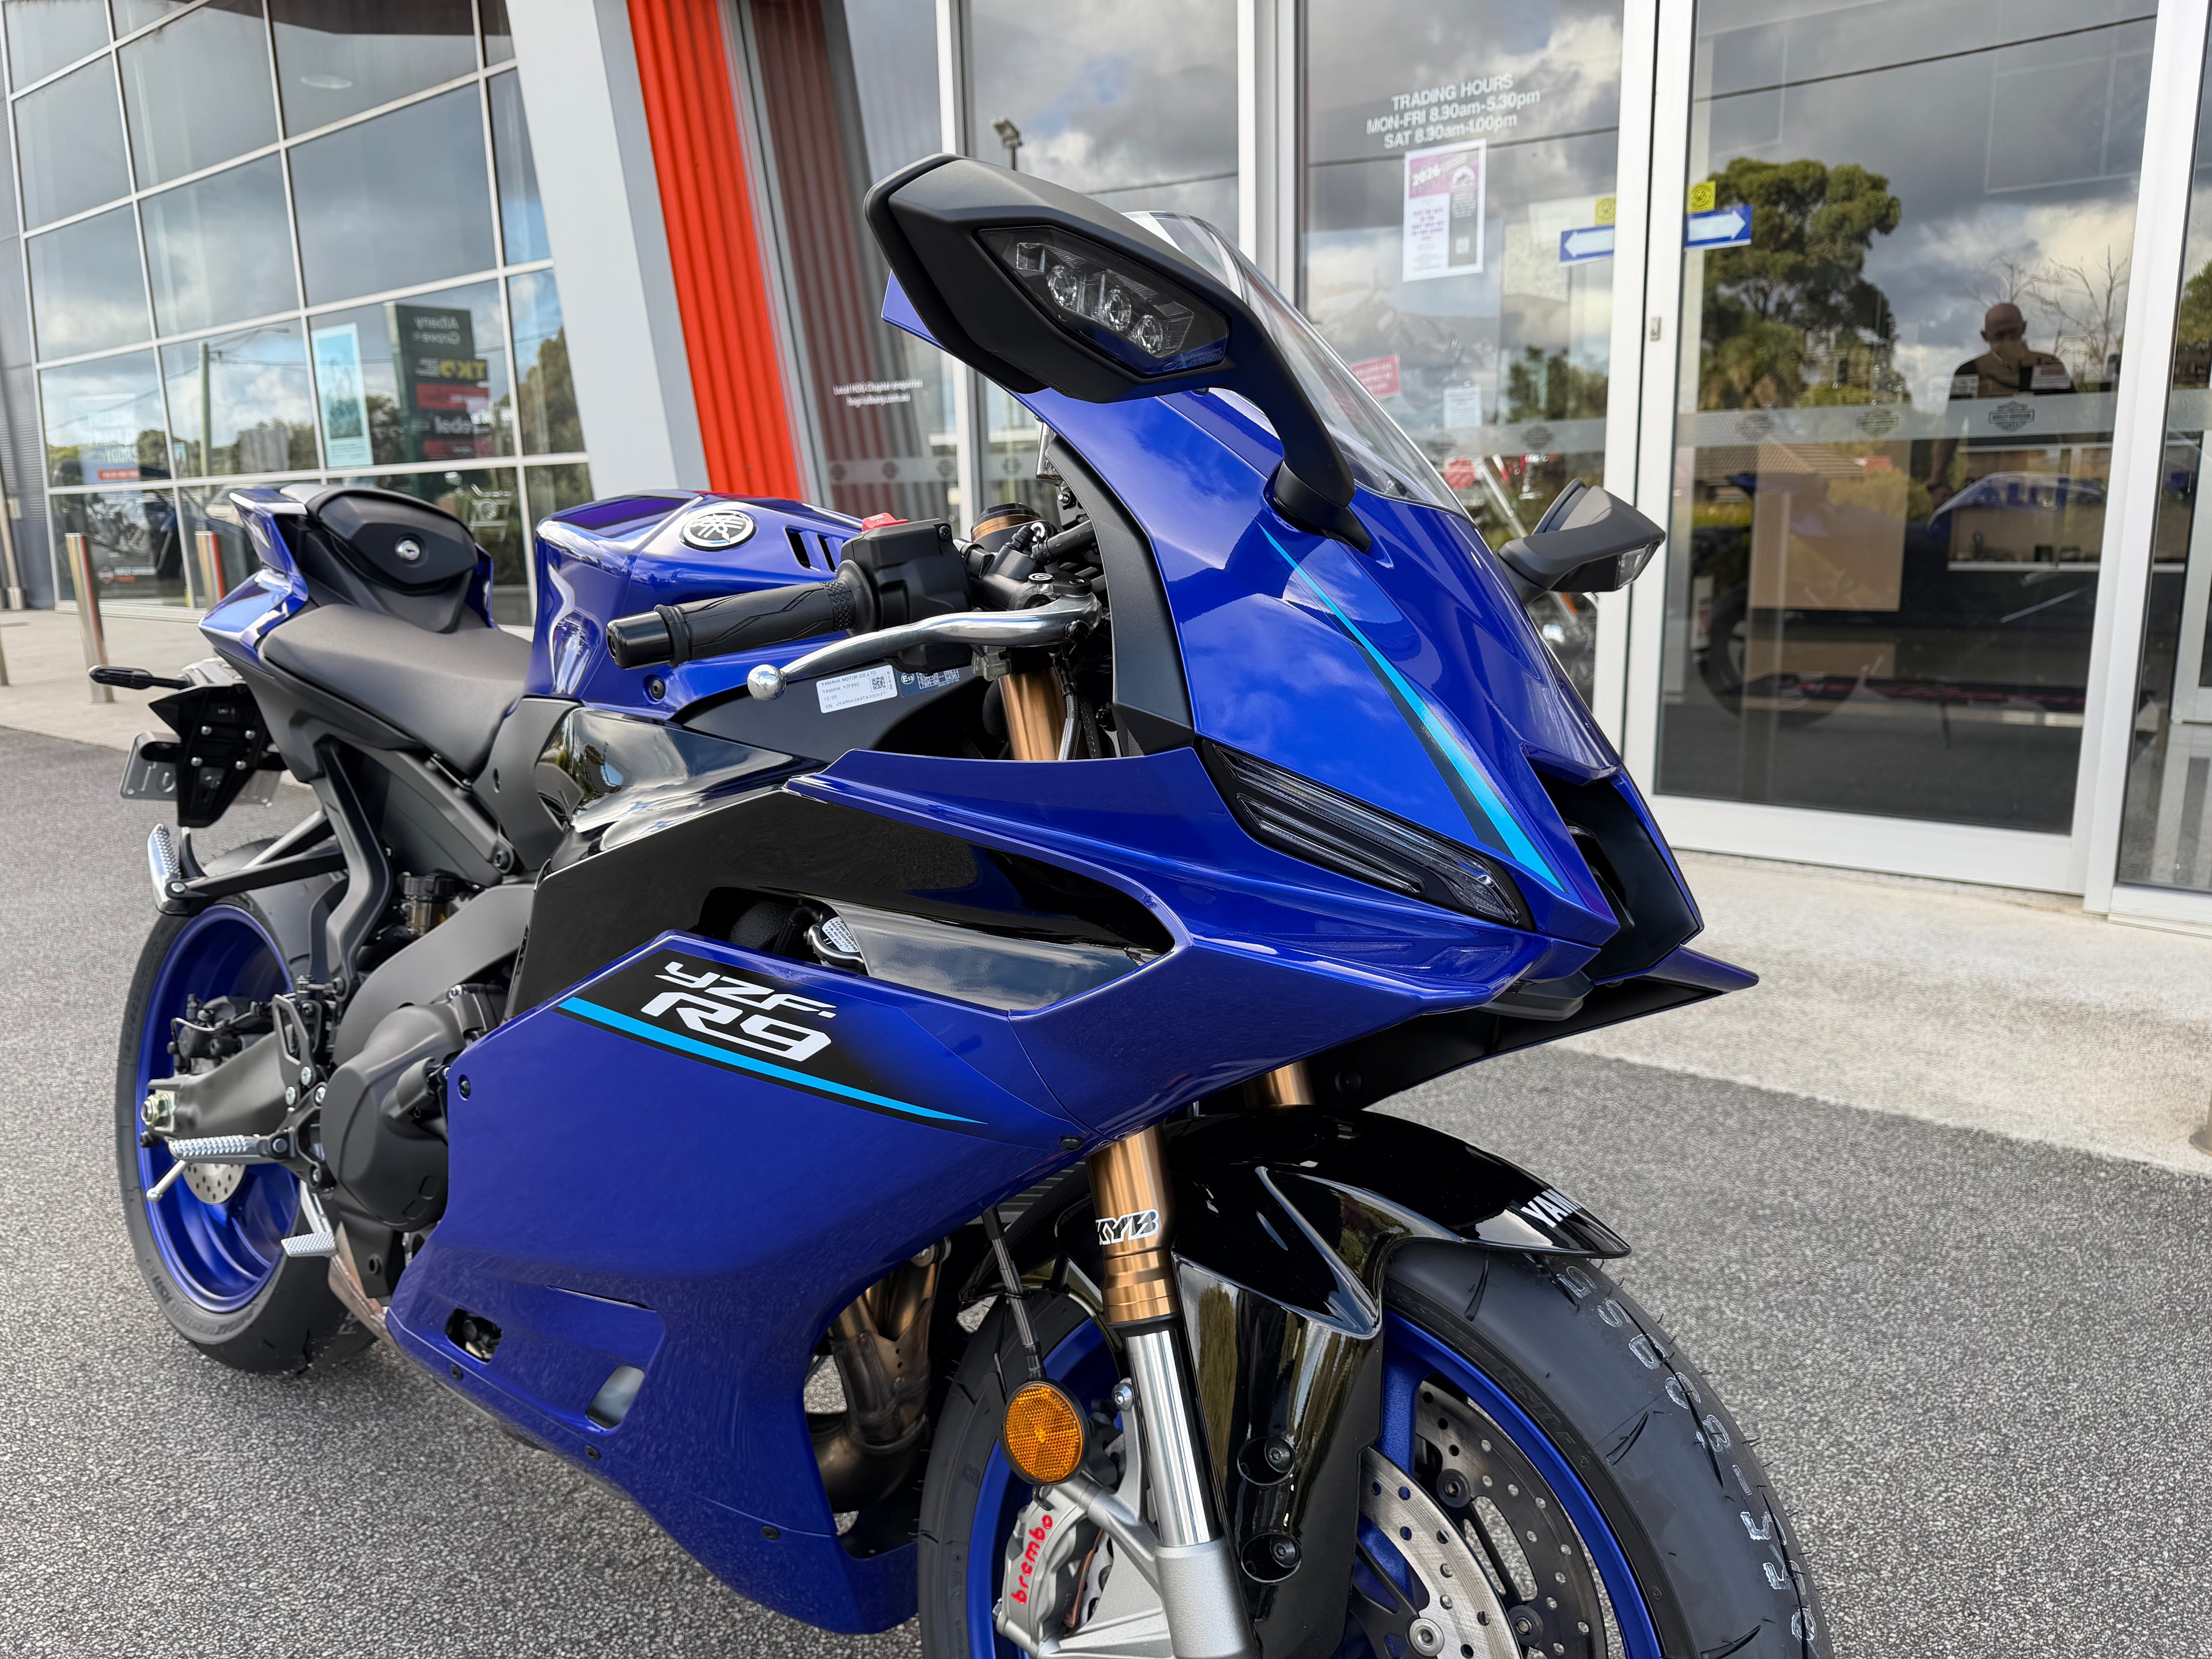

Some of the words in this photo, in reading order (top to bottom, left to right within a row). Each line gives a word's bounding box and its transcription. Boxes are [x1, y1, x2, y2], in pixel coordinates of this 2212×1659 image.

[1391, 85, 1457, 111] TRADING
[1460, 73, 1514, 98] HOURS
[1366, 108, 1426, 135] MON-FRI
[1384, 131, 1412, 149] SAT
[821, 679, 840, 687] YAMAHA
[641, 992, 832, 1061] R9
[1096, 1209, 1159, 1245] KYB
[1010, 1514, 1053, 1605] brembo
